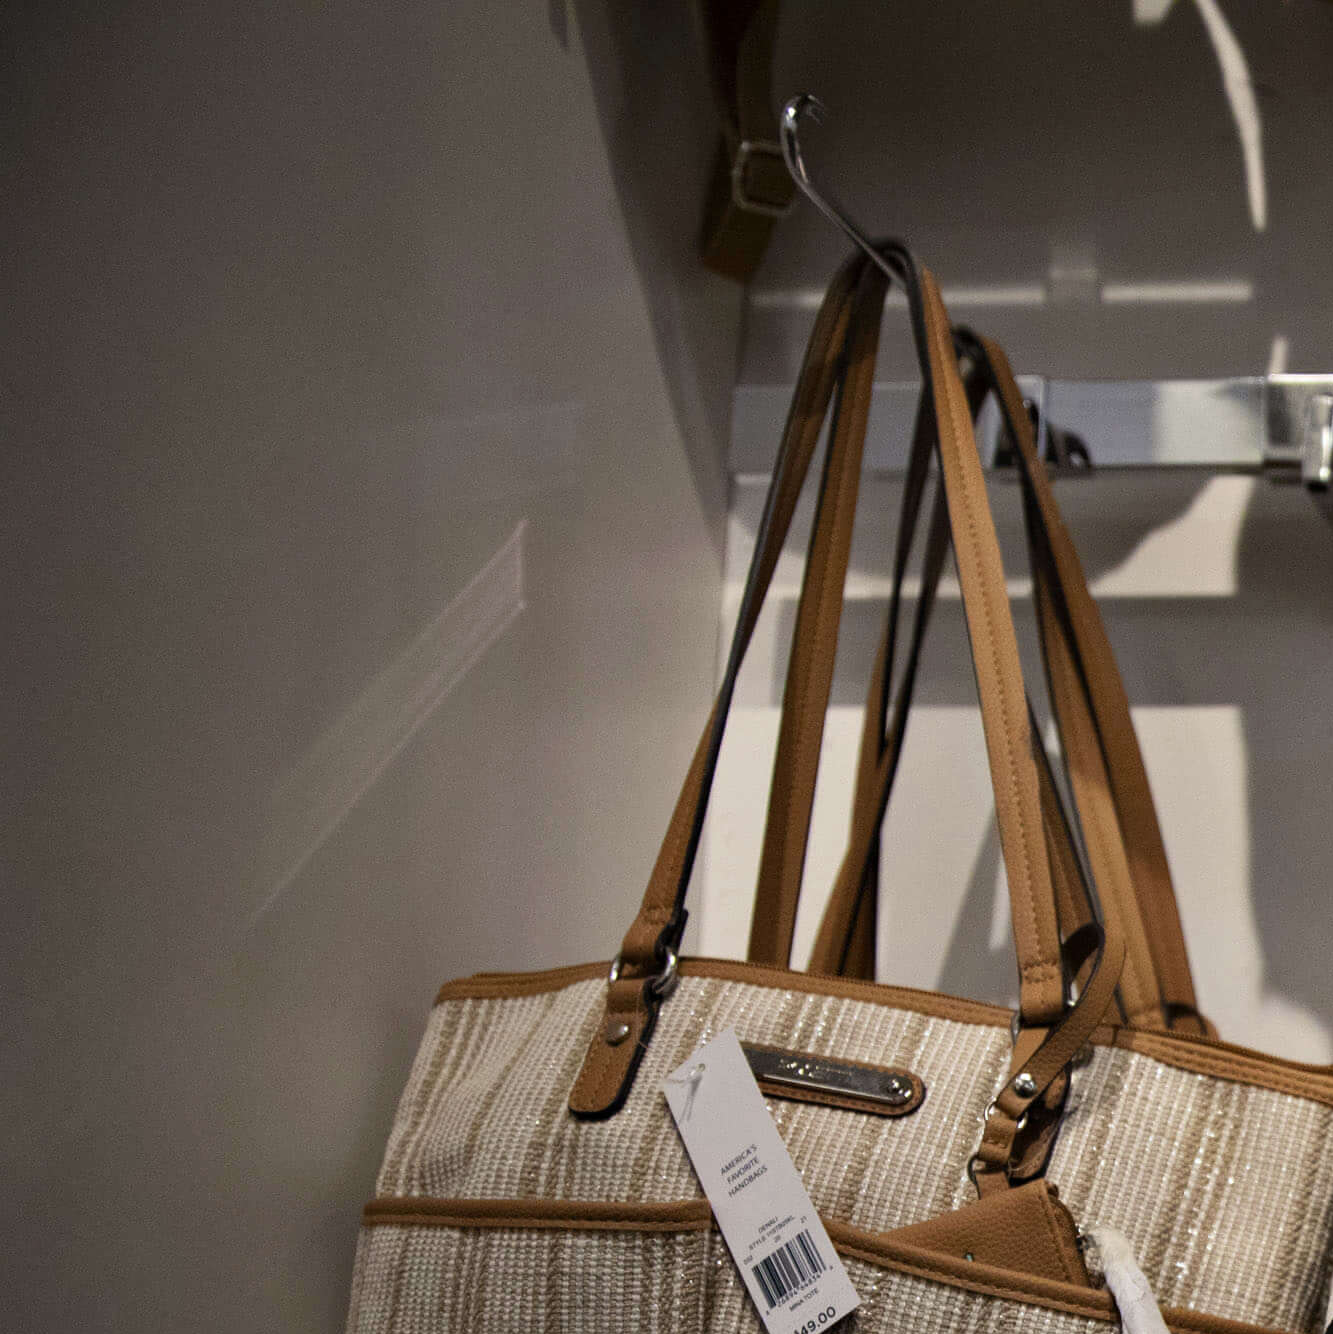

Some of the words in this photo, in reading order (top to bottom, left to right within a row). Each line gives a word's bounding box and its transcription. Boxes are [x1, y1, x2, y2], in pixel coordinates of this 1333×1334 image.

[720, 1143, 758, 1175] AMERICA'S
[727, 1156, 760, 1185] FAVORITE
[728, 1164, 768, 1197] HANDBAGS
